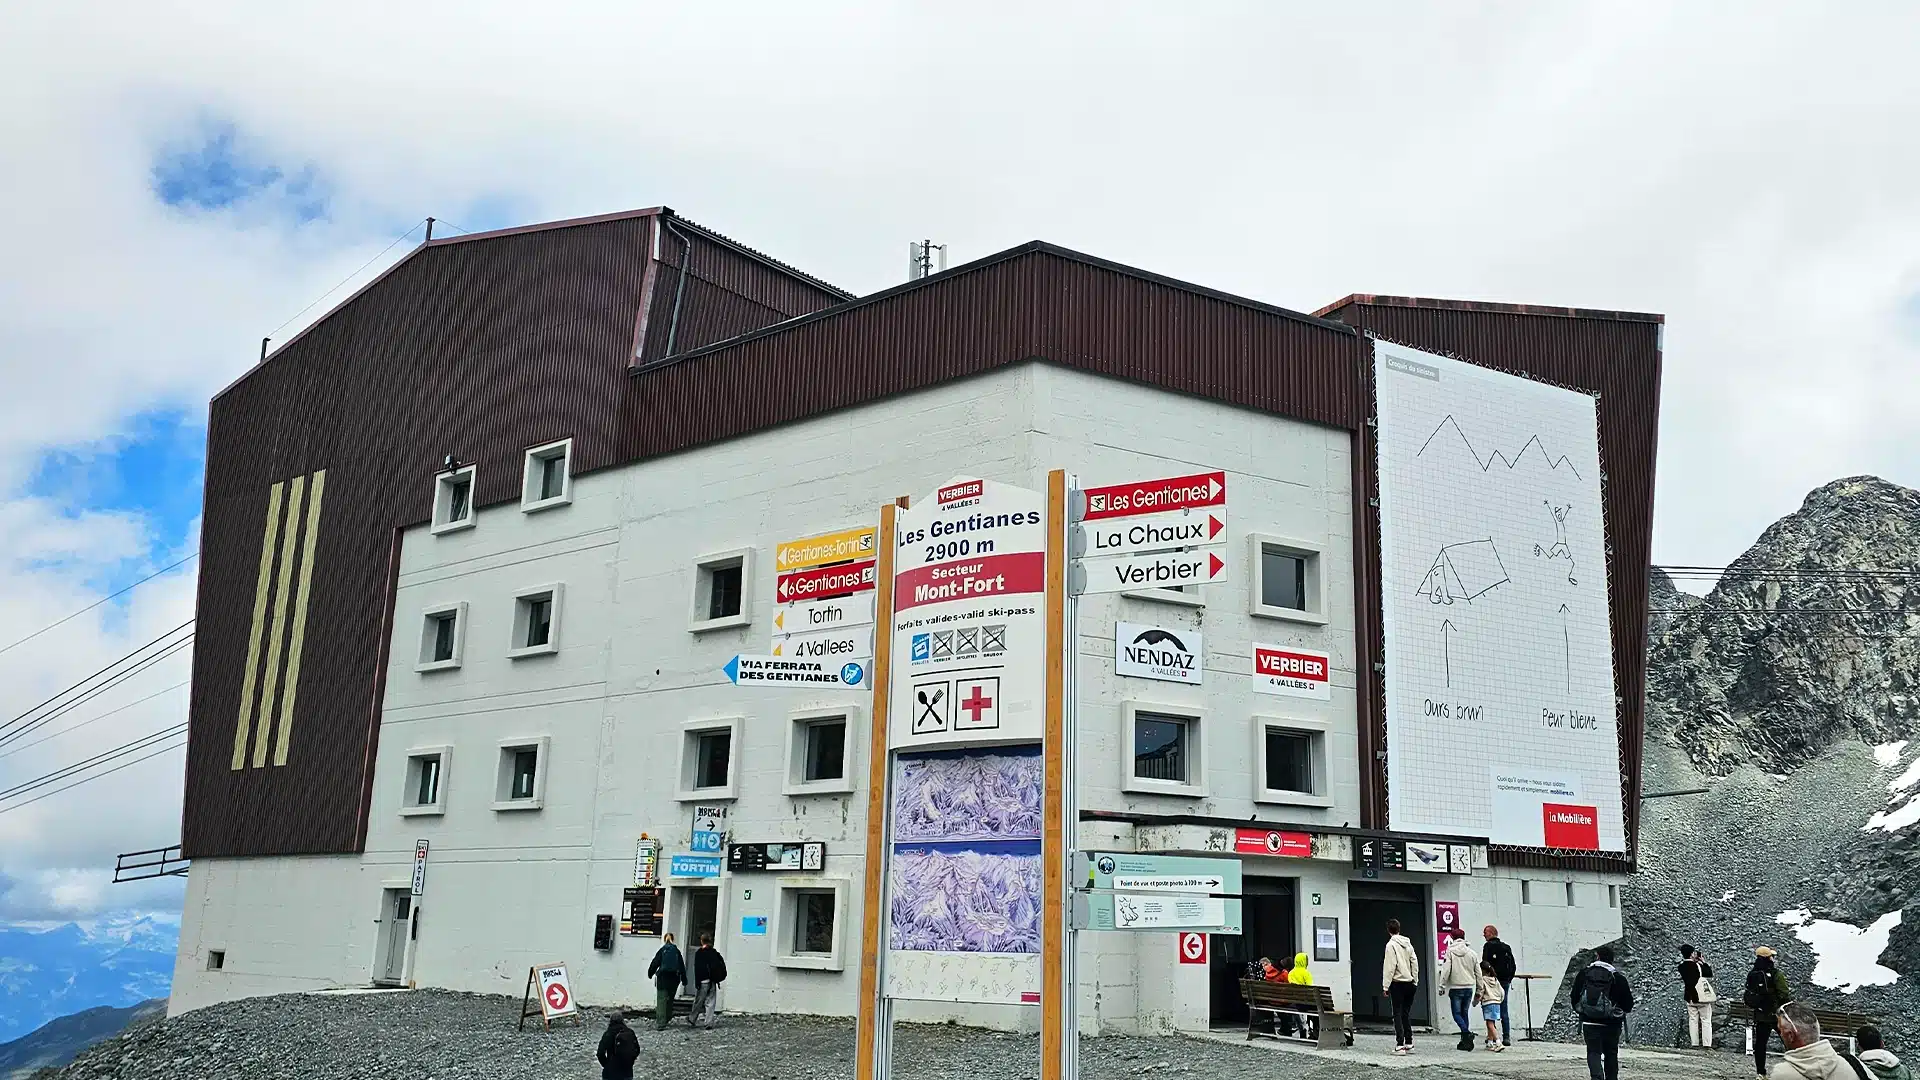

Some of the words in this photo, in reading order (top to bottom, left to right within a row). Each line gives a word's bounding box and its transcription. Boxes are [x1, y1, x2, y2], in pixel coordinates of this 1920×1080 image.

[940, 485, 980, 500] VERBIER
[1107, 493, 1129, 511] Les
[1132, 484, 1208, 508] Gentianes
[941, 504, 946, 512] 4
[946, 499, 973, 511] VALLÉES
[899, 529, 925, 548] Les
[930, 511, 1041, 538] Gentianes
[1096, 531, 1122, 549] La
[1128, 523, 1203, 545] Chaux
[787, 537, 860, 564] Gentianes-Tortin
[924, 539, 970, 562] 2900
[976, 539, 994, 554] m
[931, 563, 984, 580] Secteur
[1115, 559, 1202, 584] Verbier
[788, 583, 795, 596] 6
[795, 570, 860, 595] Gentianes
[914, 573, 1005, 603] Mont-Fort
[808, 605, 842, 625] Tortin
[925, 609, 985, 626] valides-valid
[987, 607, 1036, 618] ski-pass
[796, 642, 804, 657] 4
[806, 639, 854, 657] Vallees
[1124, 646, 1196, 670] NENDAZ
[740, 660, 763, 669] VIA
[765, 661, 822, 672] FERRATA
[1150, 666, 1155, 674] 4
[1156, 668, 1180, 677] VALLÉES
[1259, 654, 1324, 676] VERBIER
[740, 671, 765, 681] DES
[766, 672, 839, 683] GENTIANES
[1269, 678, 1275, 686] 4
[1276, 678, 1308, 690] VALLÉES
[1424, 698, 1450, 719] Ours
[1456, 700, 1484, 721] brun
[1542, 707, 1565, 728] Peur
[1569, 709, 1598, 731] bleue
[1497, 784, 1521, 792] rapidement
[1549, 811, 1556, 822] la
[1557, 812, 1592, 825] Mobilière
[672, 862, 720, 873] TORTIN
